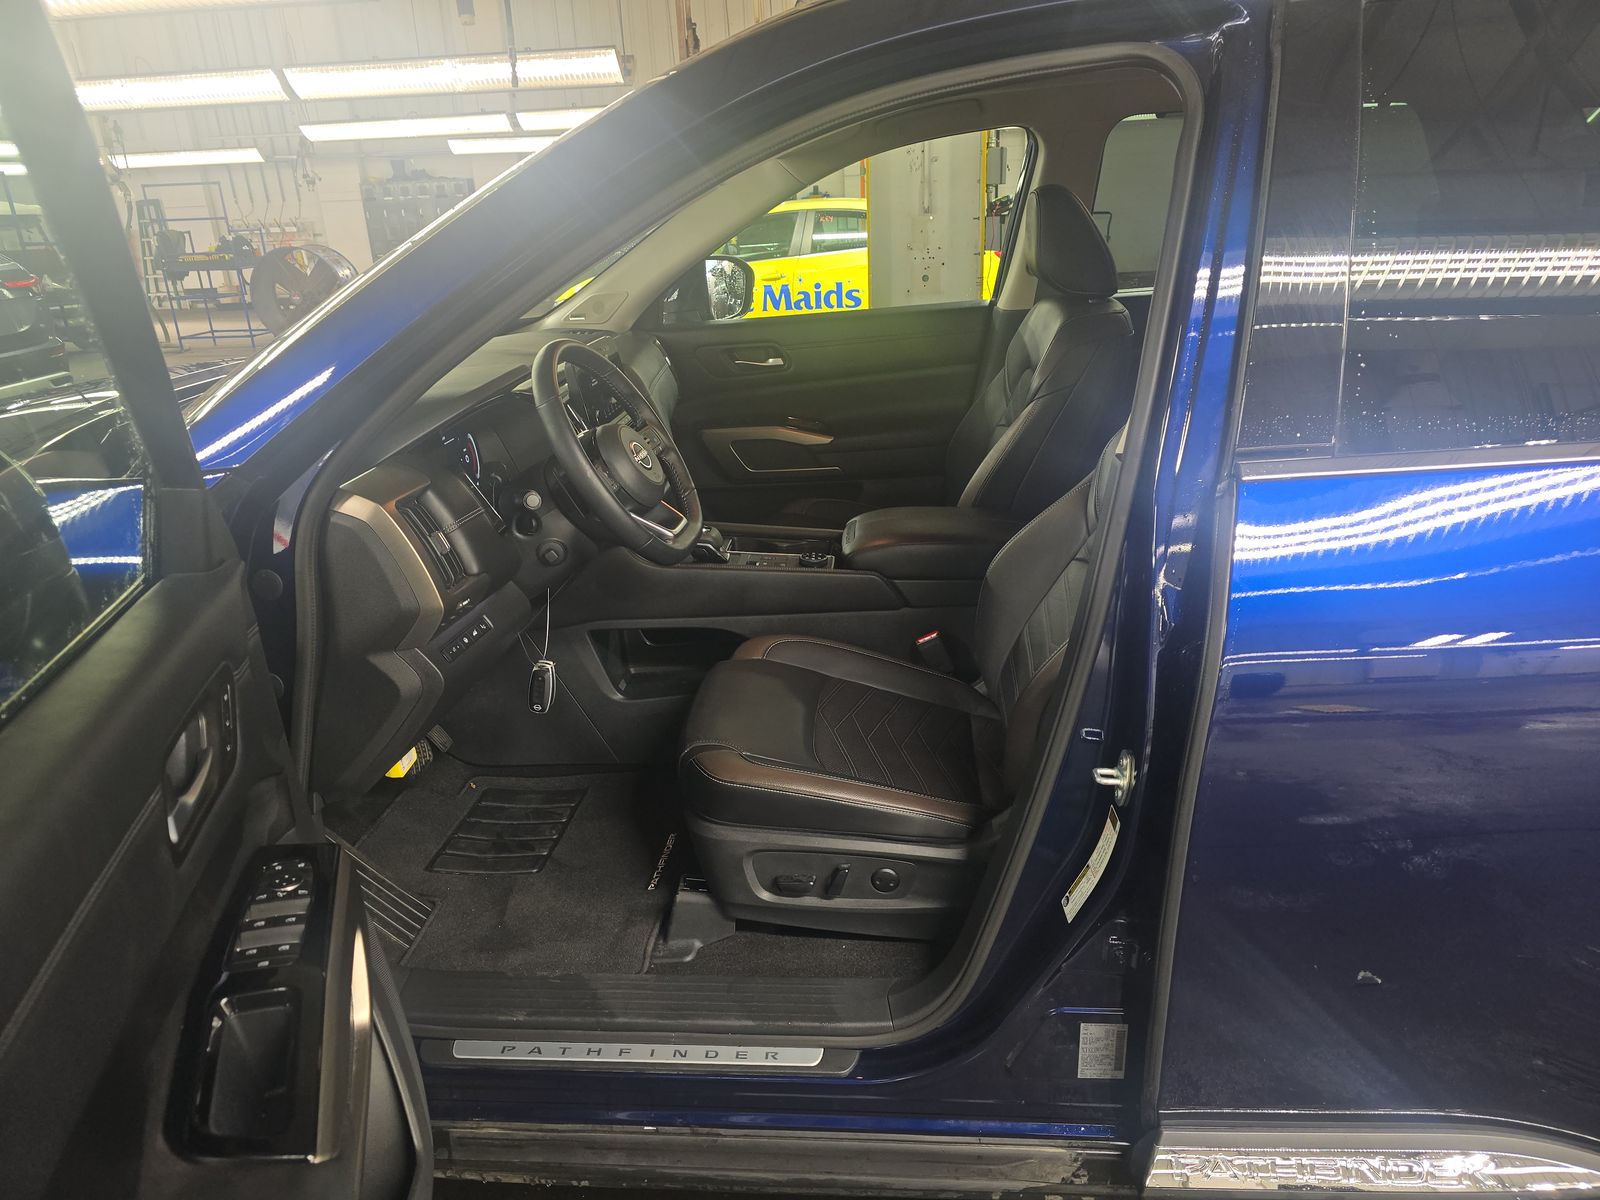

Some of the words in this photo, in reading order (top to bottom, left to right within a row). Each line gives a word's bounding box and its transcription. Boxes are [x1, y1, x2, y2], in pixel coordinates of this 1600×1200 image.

[762, 281, 862, 312] Maids
[647, 832, 677, 890] PATHFINDER
[500, 1045, 779, 1061] PATHFINDER
